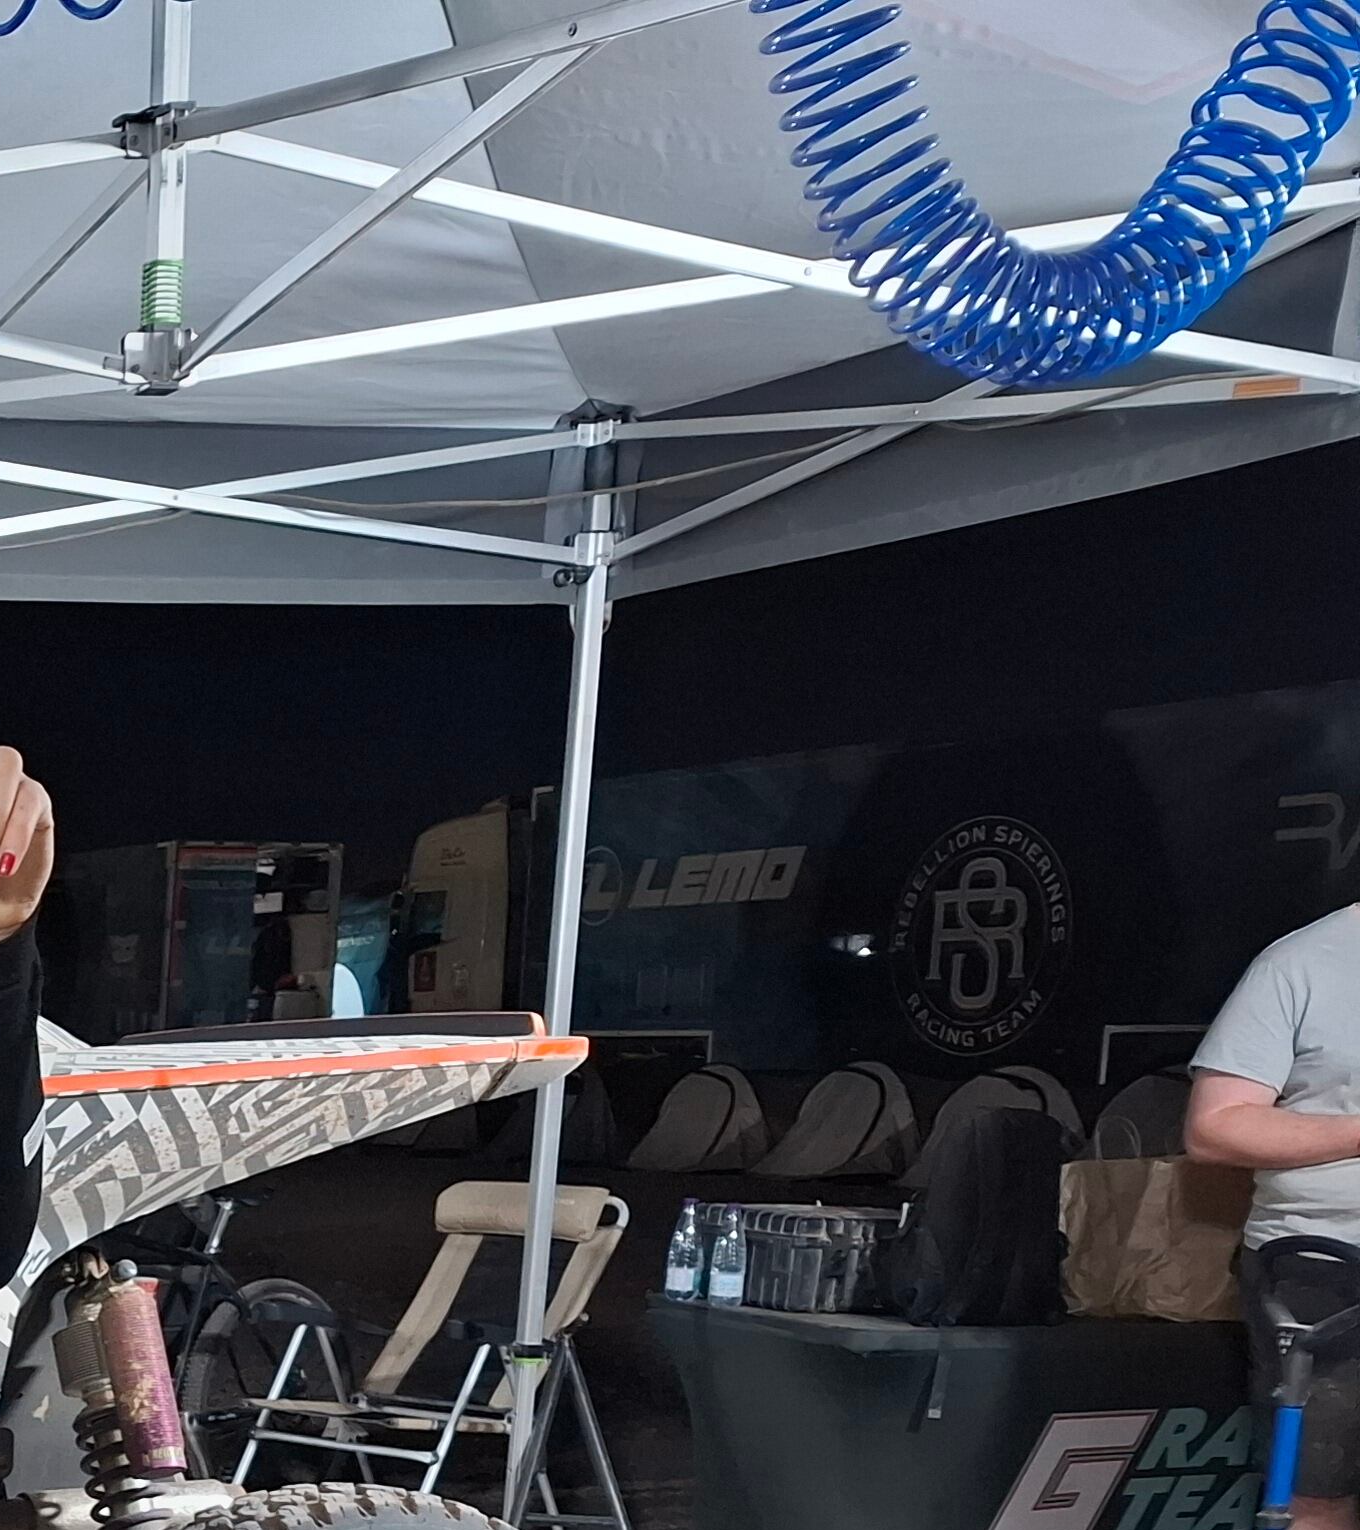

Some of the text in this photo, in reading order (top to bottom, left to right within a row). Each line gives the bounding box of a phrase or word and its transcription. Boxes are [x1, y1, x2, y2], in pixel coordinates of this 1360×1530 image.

[628, 846, 807, 909] LEMO
[994, 825, 1067, 943] SPIERINGS
[907, 989, 1043, 1047] RACING TEAM
